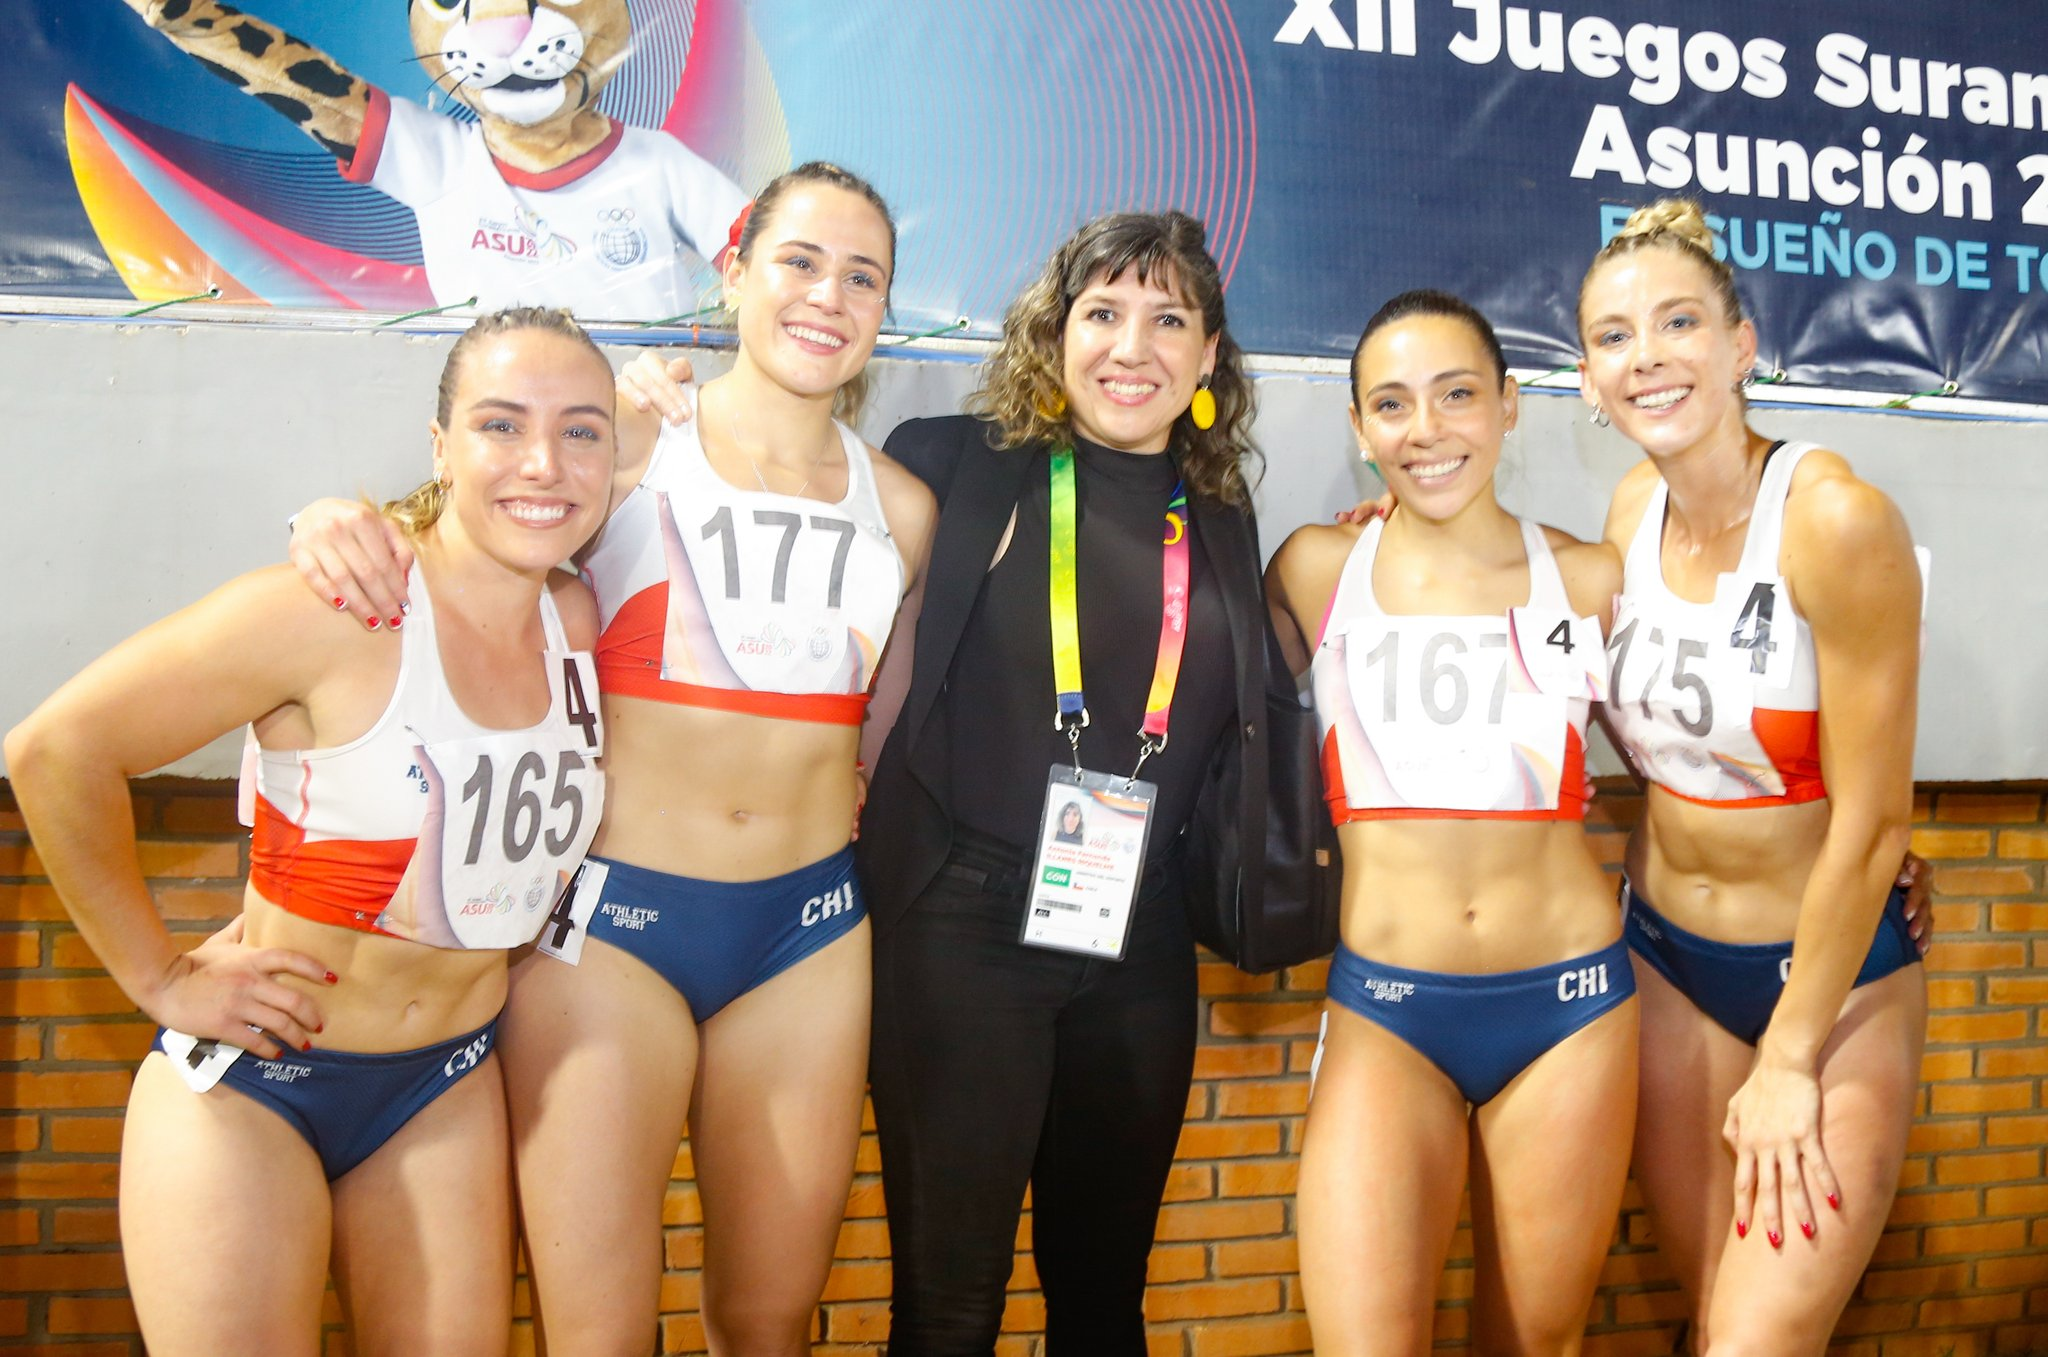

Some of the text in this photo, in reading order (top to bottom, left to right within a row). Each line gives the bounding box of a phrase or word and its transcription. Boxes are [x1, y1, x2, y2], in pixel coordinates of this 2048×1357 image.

[1273, 0, 1417, 56] XII
[1448, 0, 1788, 104] Juegos
[1570, 104, 2048, 226] Asunción 2
[1703, 210, 1897, 281] SUEÑO
[1914, 235, 1991, 290] DE
[2005, 244, 2048, 293] T
[700, 505, 857, 609] 177
[1545, 619, 1576, 654] 4
[1730, 581, 1777, 675] 4
[563, 657, 597, 748] 4
[1365, 630, 1508, 726] 167
[1607, 617, 1714, 737] 175
[462, 750, 586, 866] 165
[600, 902, 660, 923] ATHLETIC
[612, 916, 646, 931] SPORT
[801, 881, 855, 927] CHI
[1558, 963, 1609, 1002] CHI
[254, 1059, 313, 1078] ATHLETIC
[263, 1069, 298, 1084] SPORT
[444, 1032, 489, 1078] CHI
